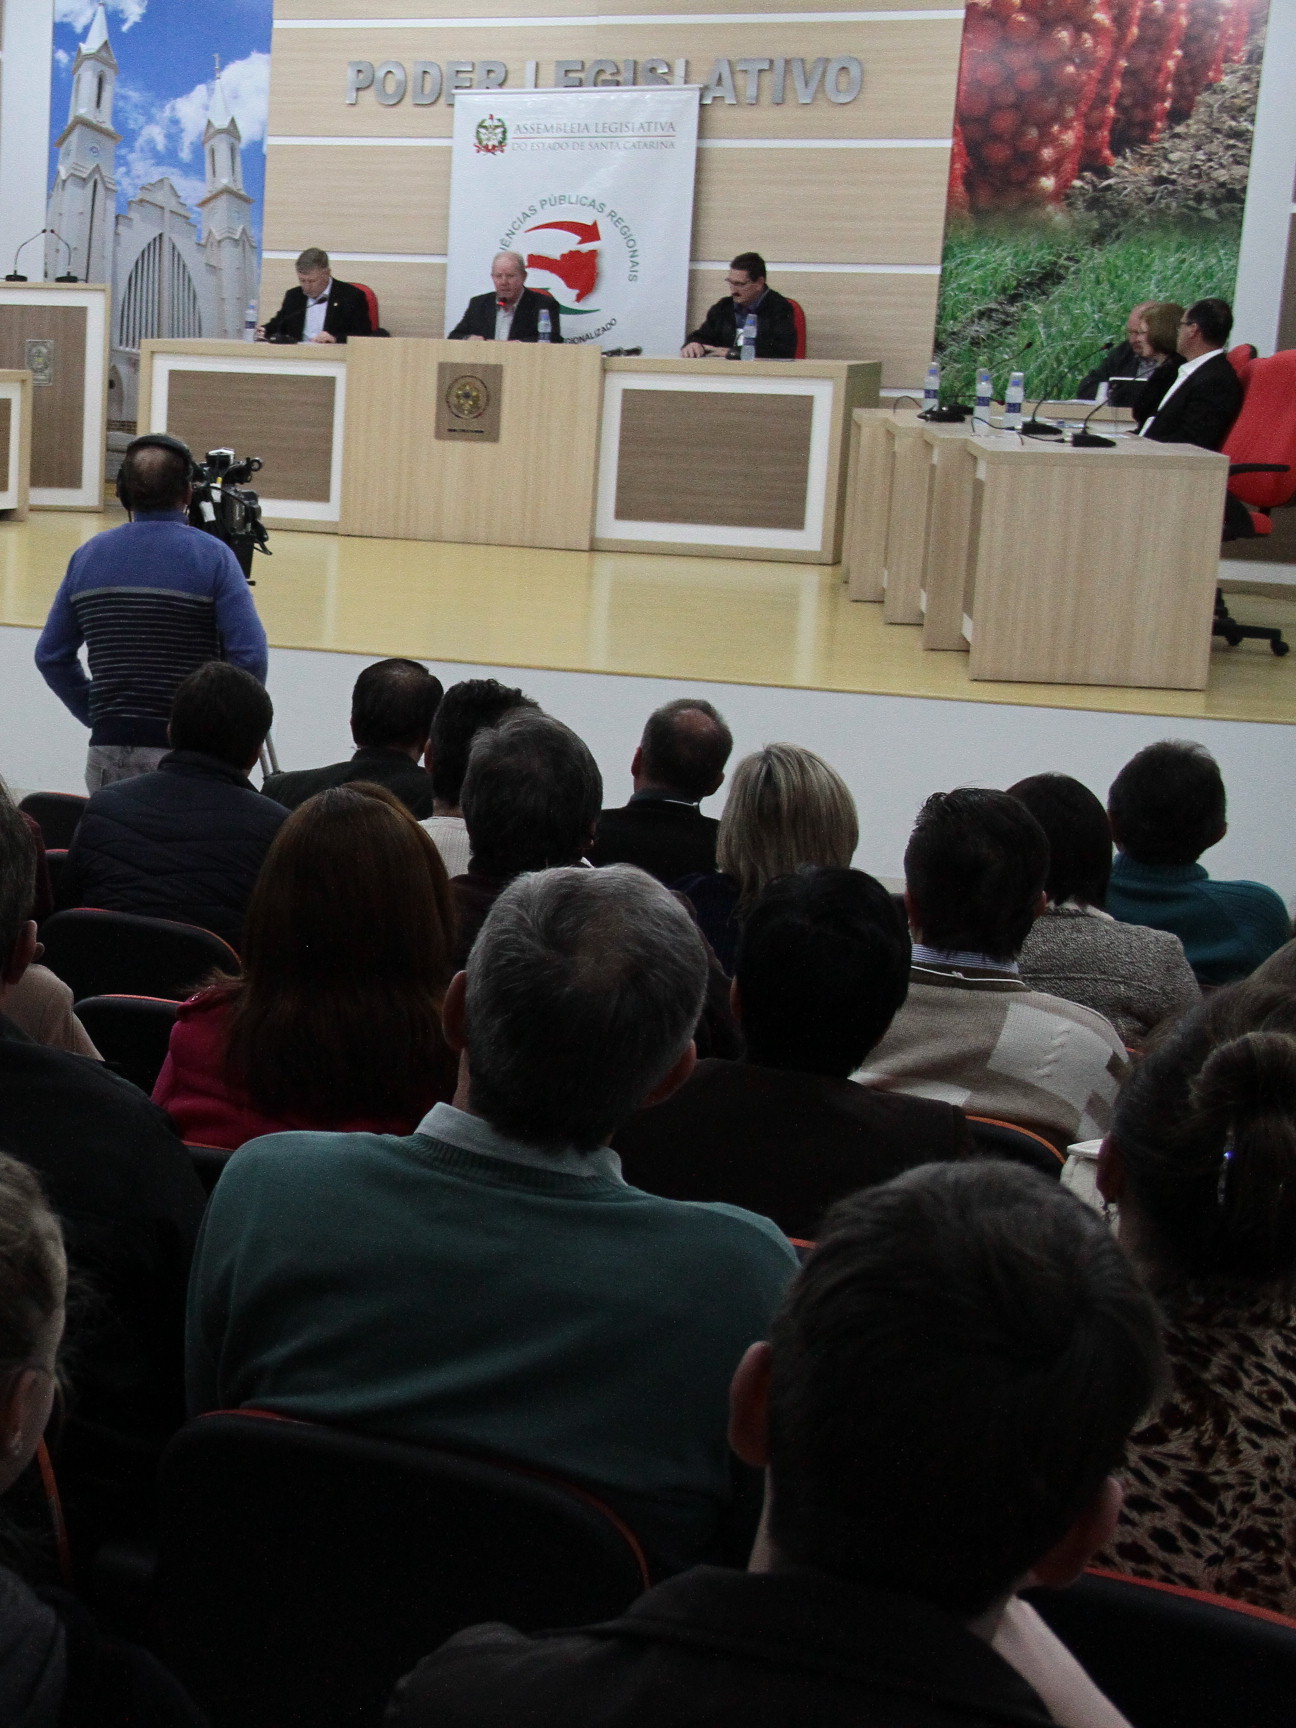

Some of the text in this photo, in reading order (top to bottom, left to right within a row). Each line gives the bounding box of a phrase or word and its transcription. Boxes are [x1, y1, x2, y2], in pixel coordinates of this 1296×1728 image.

[346, 60, 508, 107] PODER
[514, 121, 676, 135] ASSEMBLEIA LEGISLATIVA
[511, 140, 676, 151] DO ESTADO DE SANTA CATARINA
[498, 193, 640, 282] IÊNCIAS PÚBLICAS REGIONAIS
[565, 317, 617, 344] GIONALIZADO
